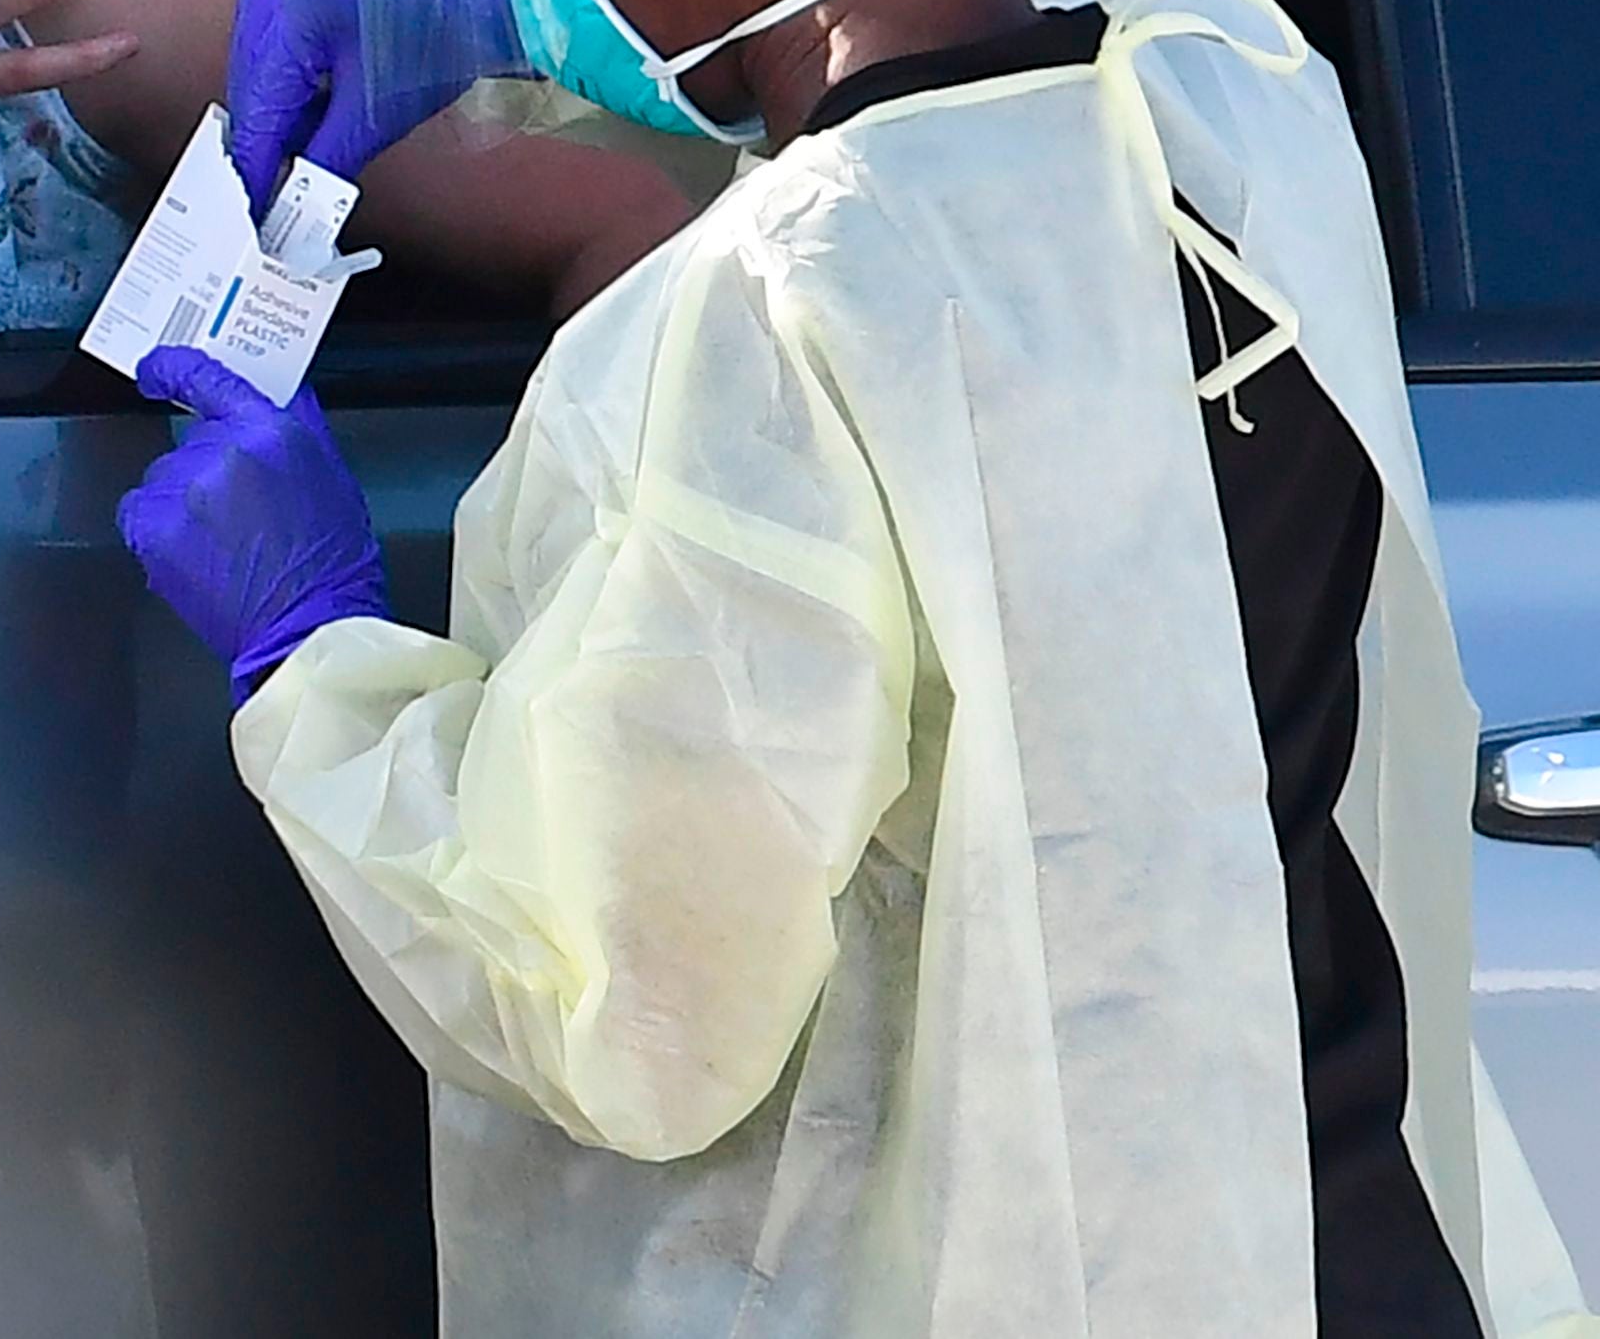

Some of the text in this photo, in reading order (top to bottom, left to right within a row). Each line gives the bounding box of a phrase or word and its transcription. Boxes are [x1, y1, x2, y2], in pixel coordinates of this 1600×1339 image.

[249, 283, 310, 319] Adhesive
[235, 317, 290, 350] PLASTIC
[242, 300, 307, 338] Bandages
[227, 335, 268, 357] STRIP
